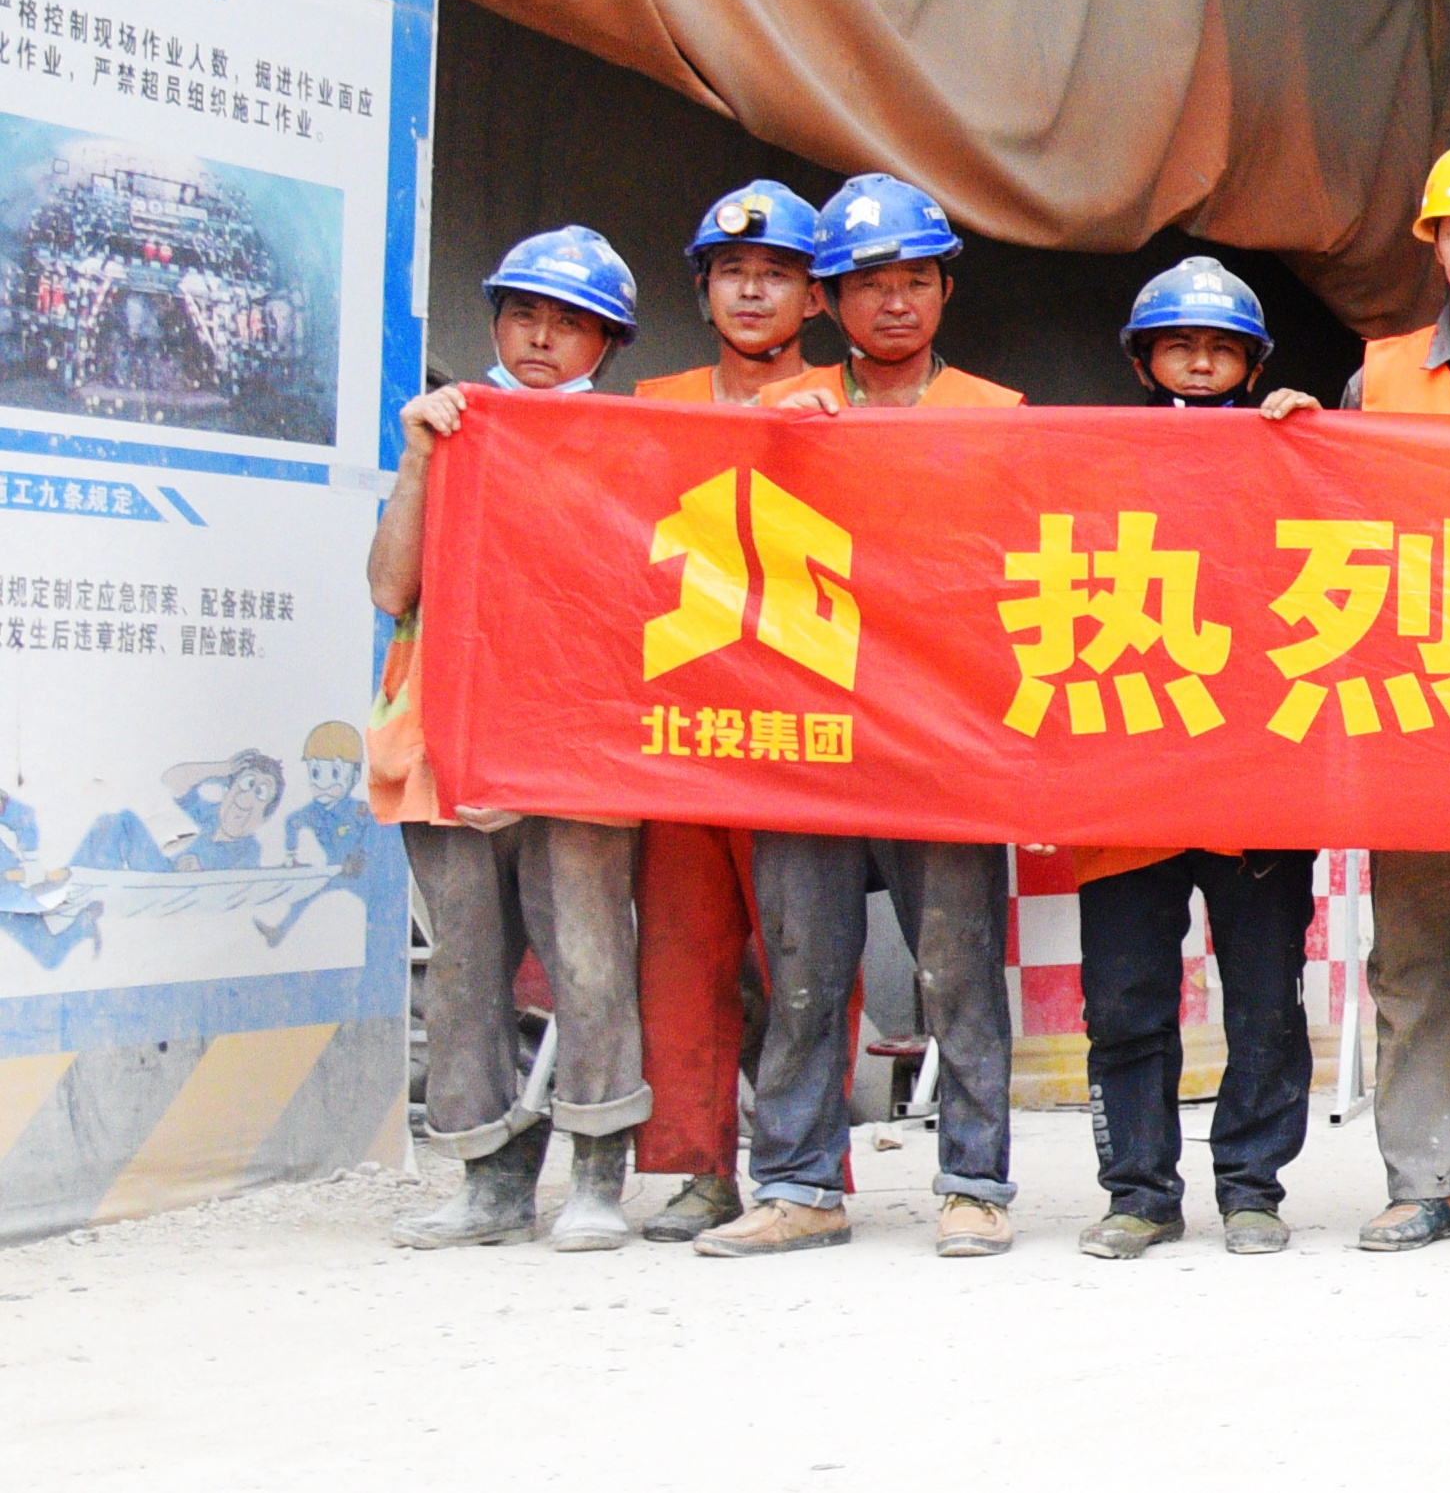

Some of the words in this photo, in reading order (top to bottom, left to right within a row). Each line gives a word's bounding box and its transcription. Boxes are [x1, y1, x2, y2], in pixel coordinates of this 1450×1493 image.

[0, 575, 295, 622] 规定制定应急预案、配备救援装
[0, 617, 267, 659] 发生后违章指挥、冒险施救。
[641, 705, 853, 763] 北投集团
